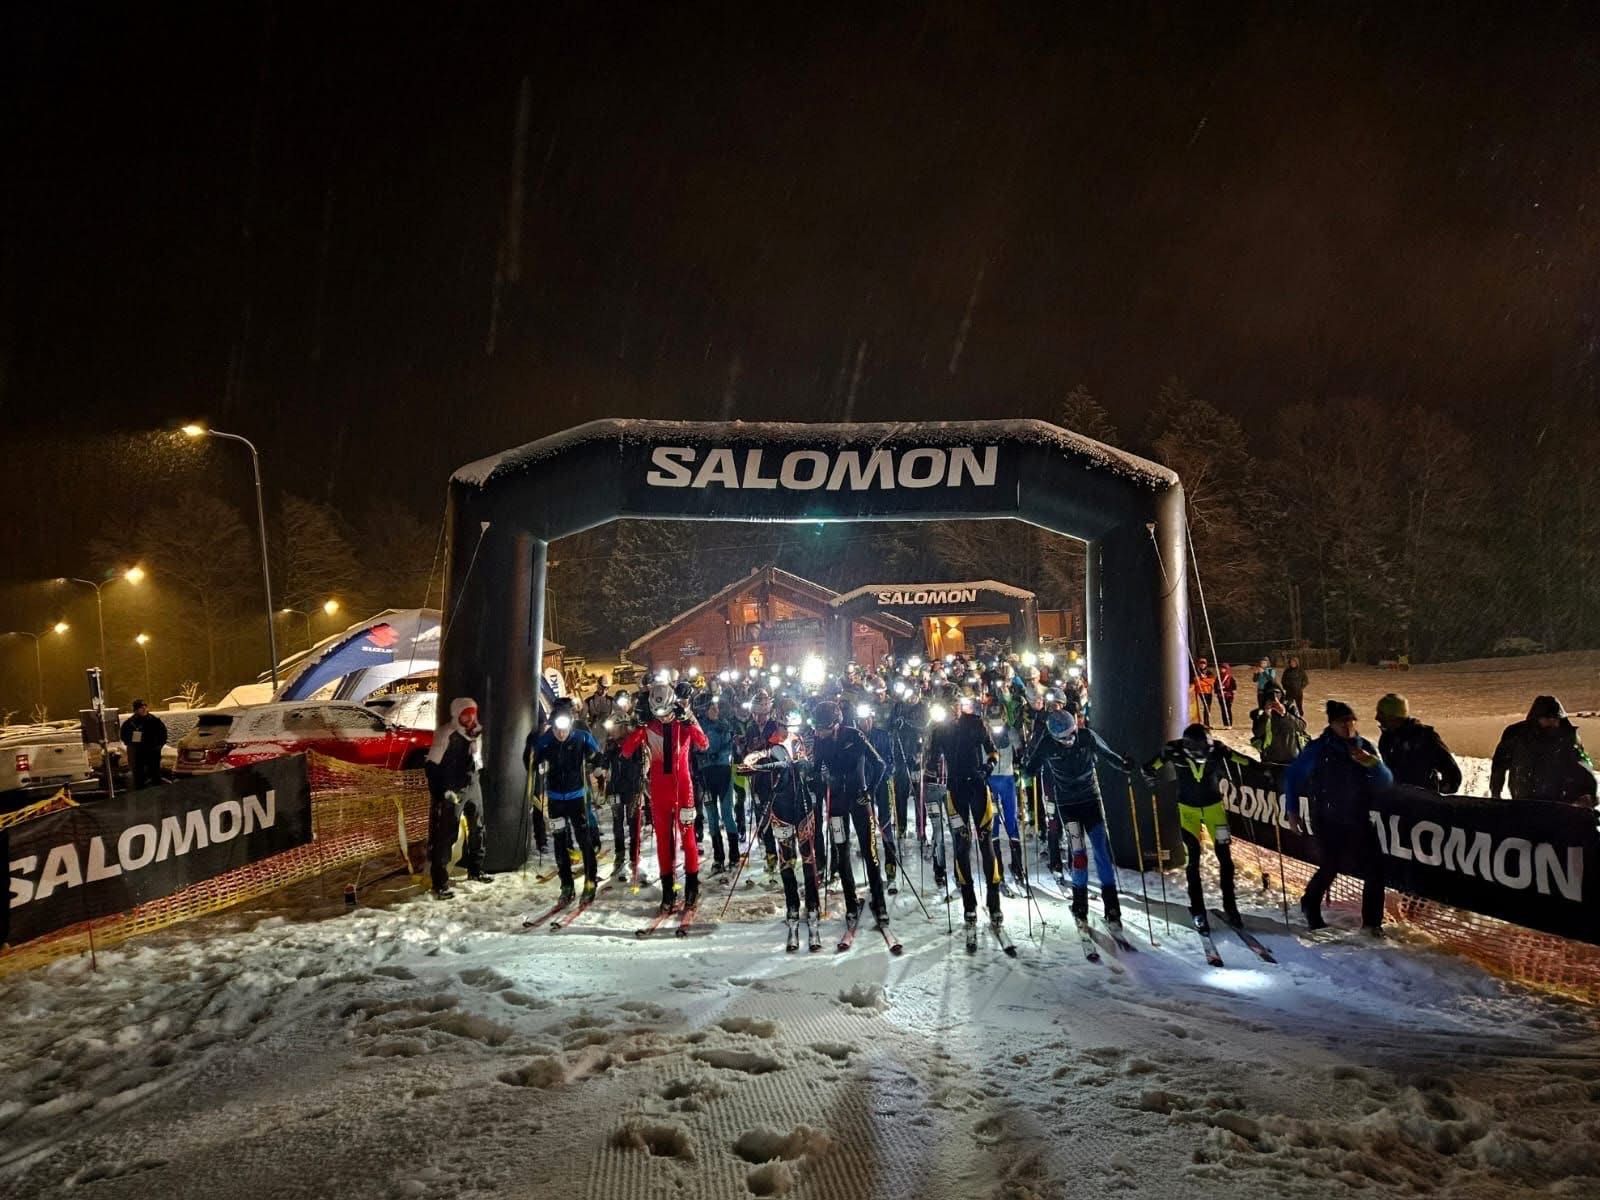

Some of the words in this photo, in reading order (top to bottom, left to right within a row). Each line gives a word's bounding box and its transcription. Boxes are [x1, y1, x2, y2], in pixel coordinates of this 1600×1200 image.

[646, 446, 998, 491] SALOMON
[877, 589, 977, 605] SALOMON
[8, 789, 276, 909] SALOMON
